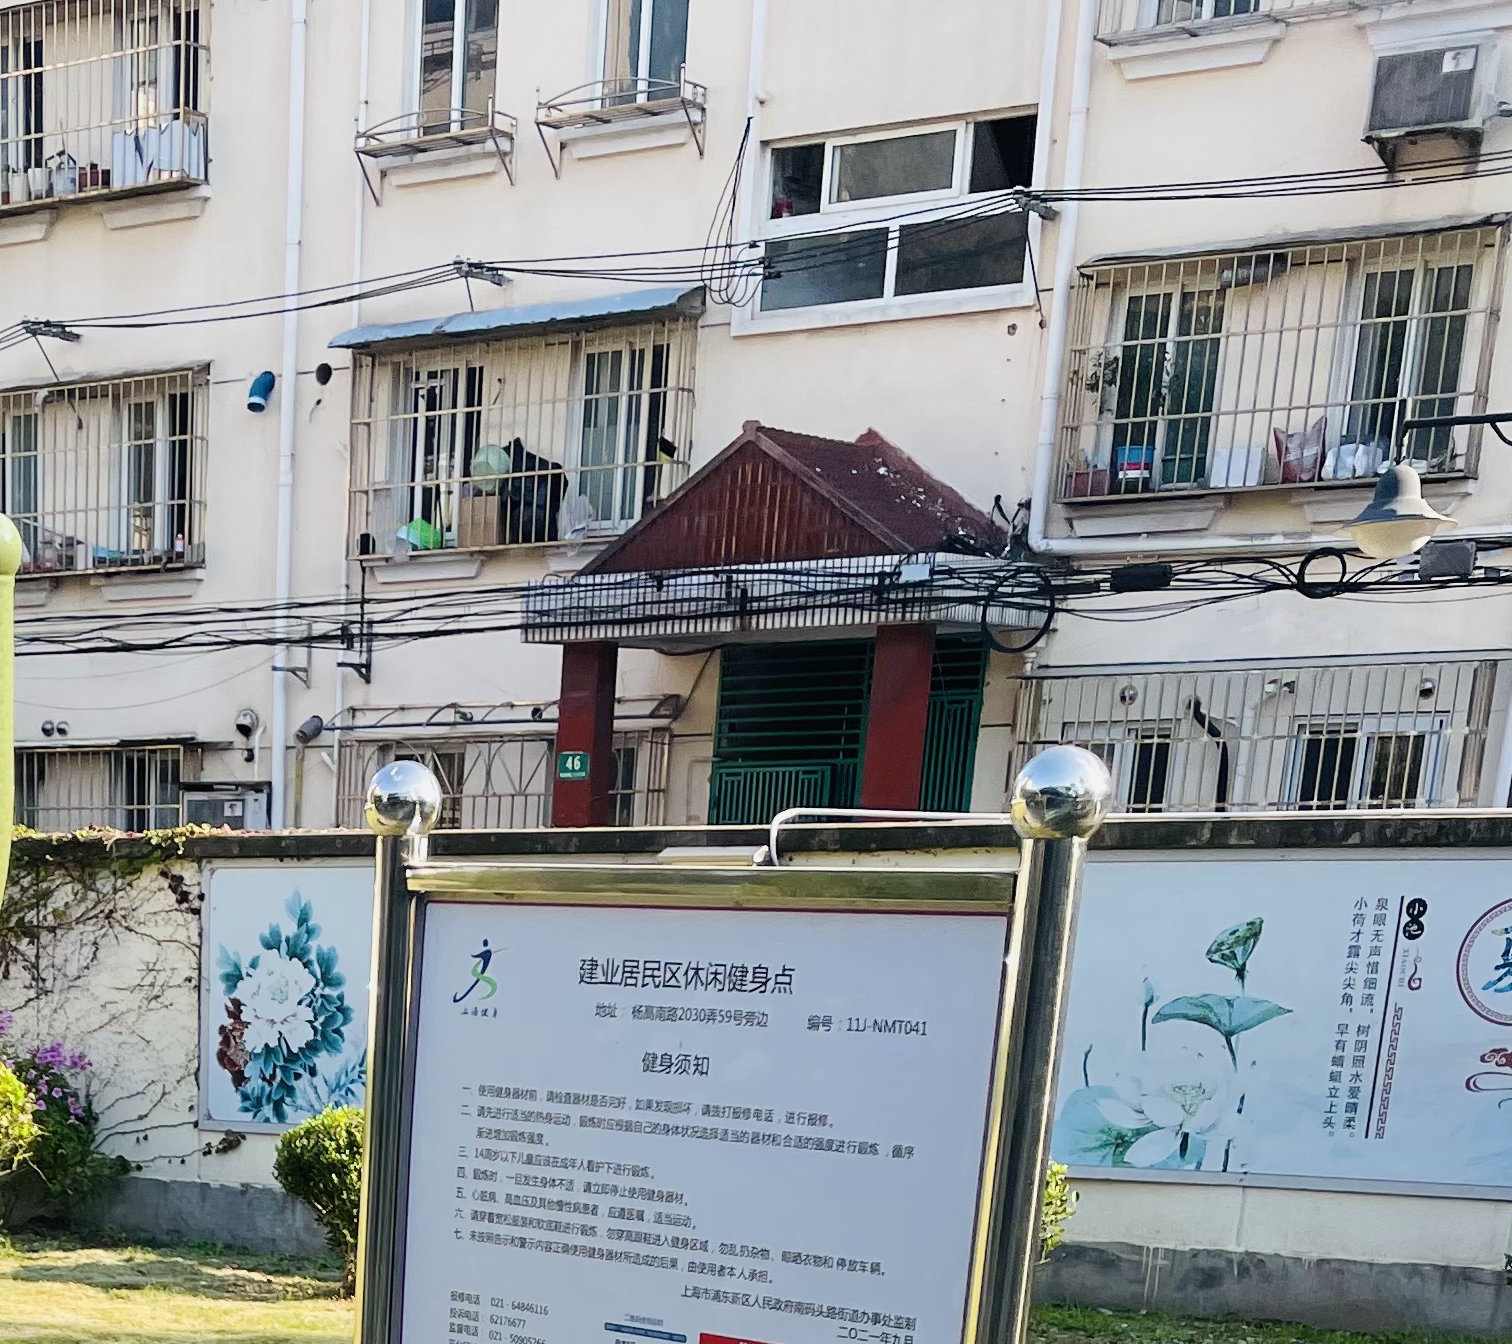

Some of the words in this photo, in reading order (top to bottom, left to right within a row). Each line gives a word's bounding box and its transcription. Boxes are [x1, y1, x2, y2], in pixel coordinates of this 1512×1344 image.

[565, 755, 581, 771] 46
[1404, 899, 1426, 939] 小池
[579, 957, 796, 996] 建业居民区休闲健身点
[641, 1050, 710, 1078] 健身须知
